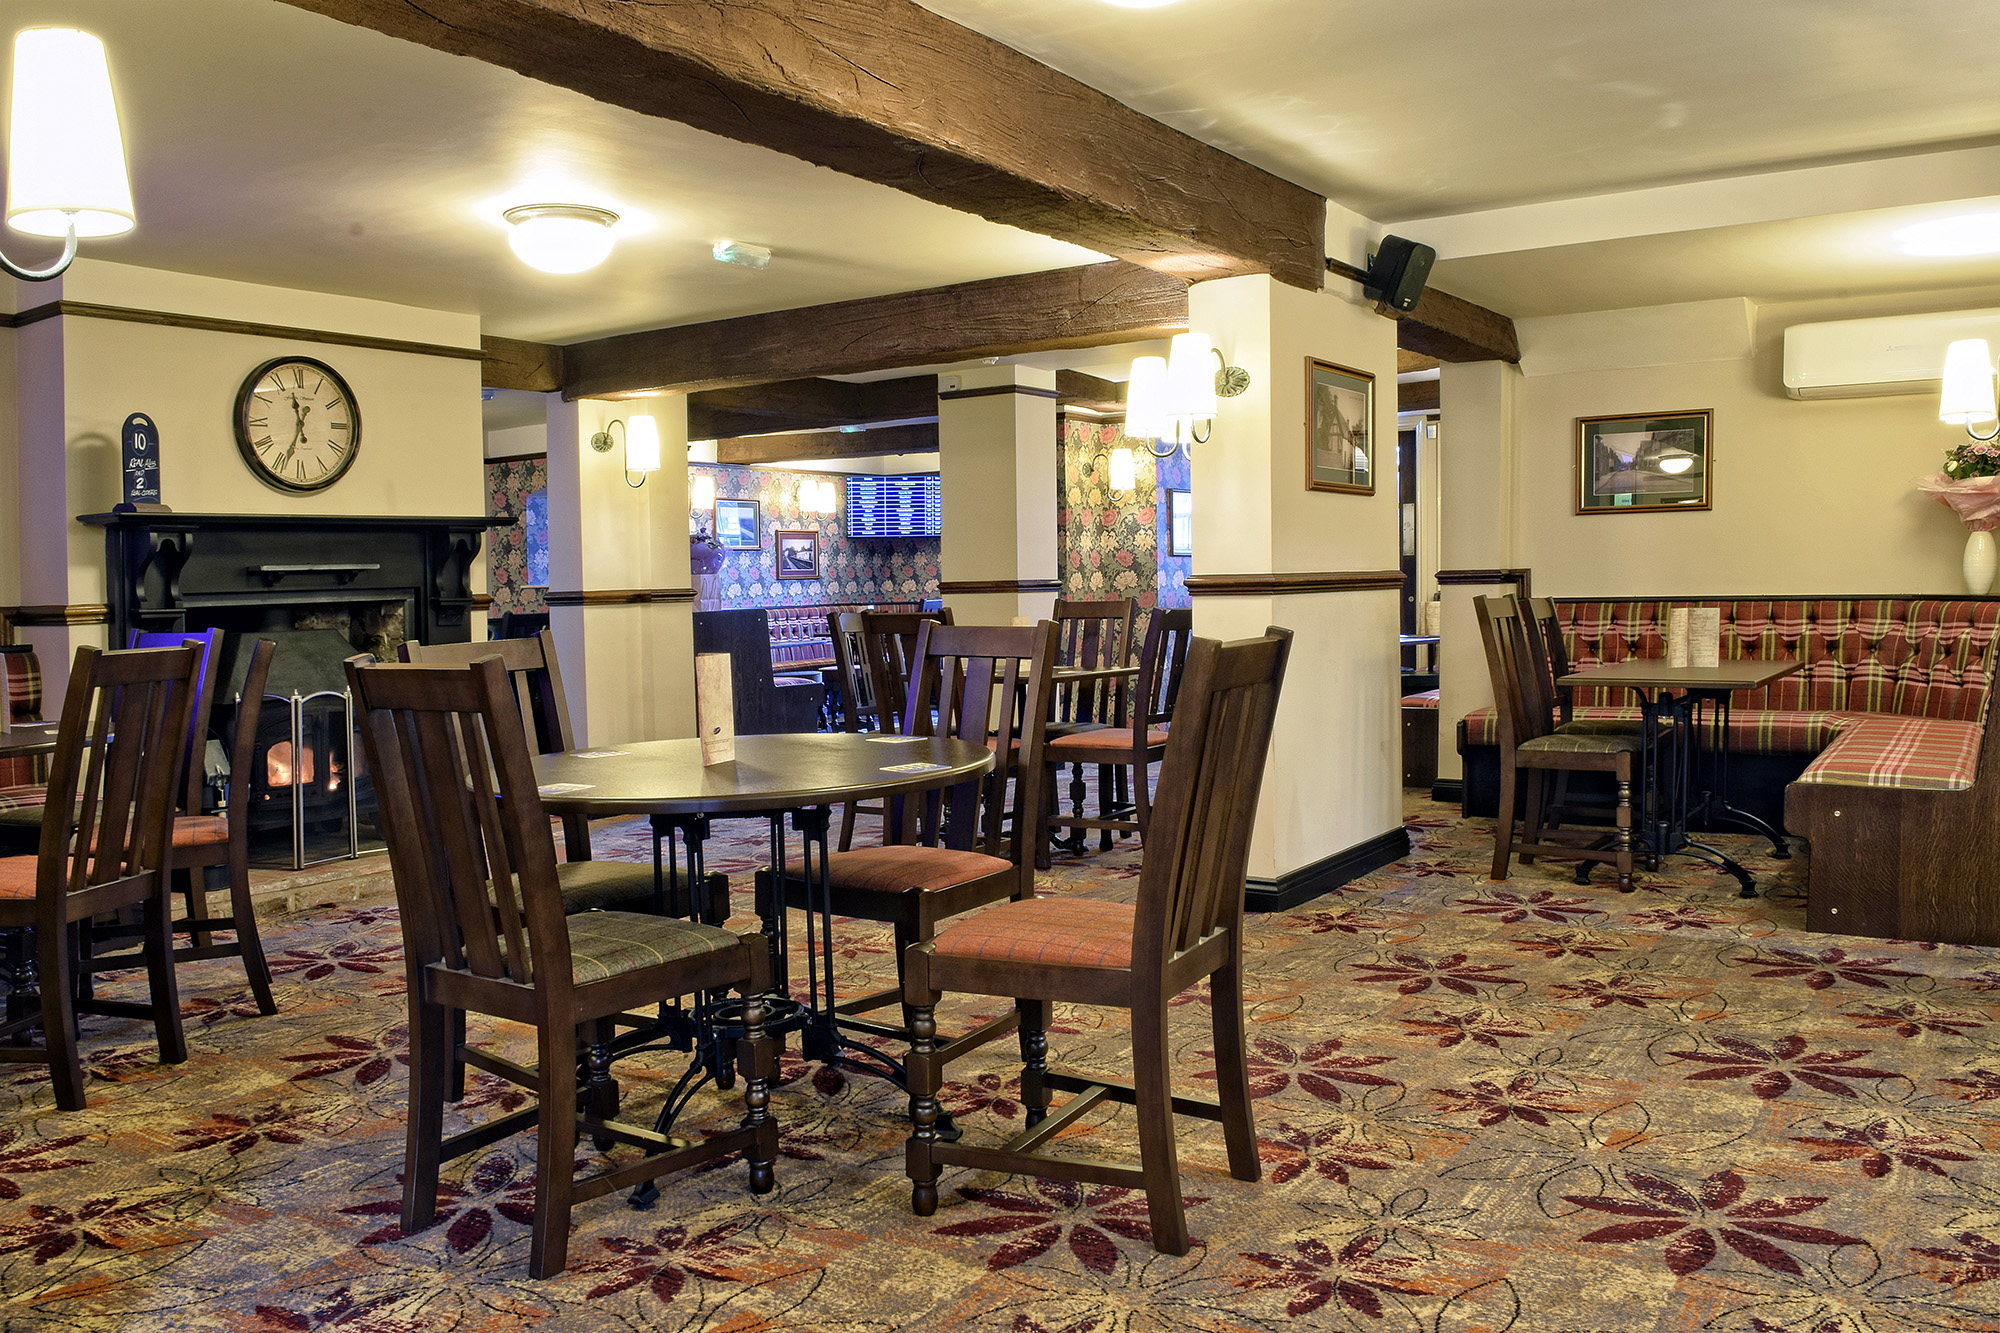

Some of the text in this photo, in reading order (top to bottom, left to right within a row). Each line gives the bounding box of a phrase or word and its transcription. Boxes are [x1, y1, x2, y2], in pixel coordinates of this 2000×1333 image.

[325, 397, 341, 410] II
[134, 433, 146, 450] 10
[136, 477, 144, 489] 2
